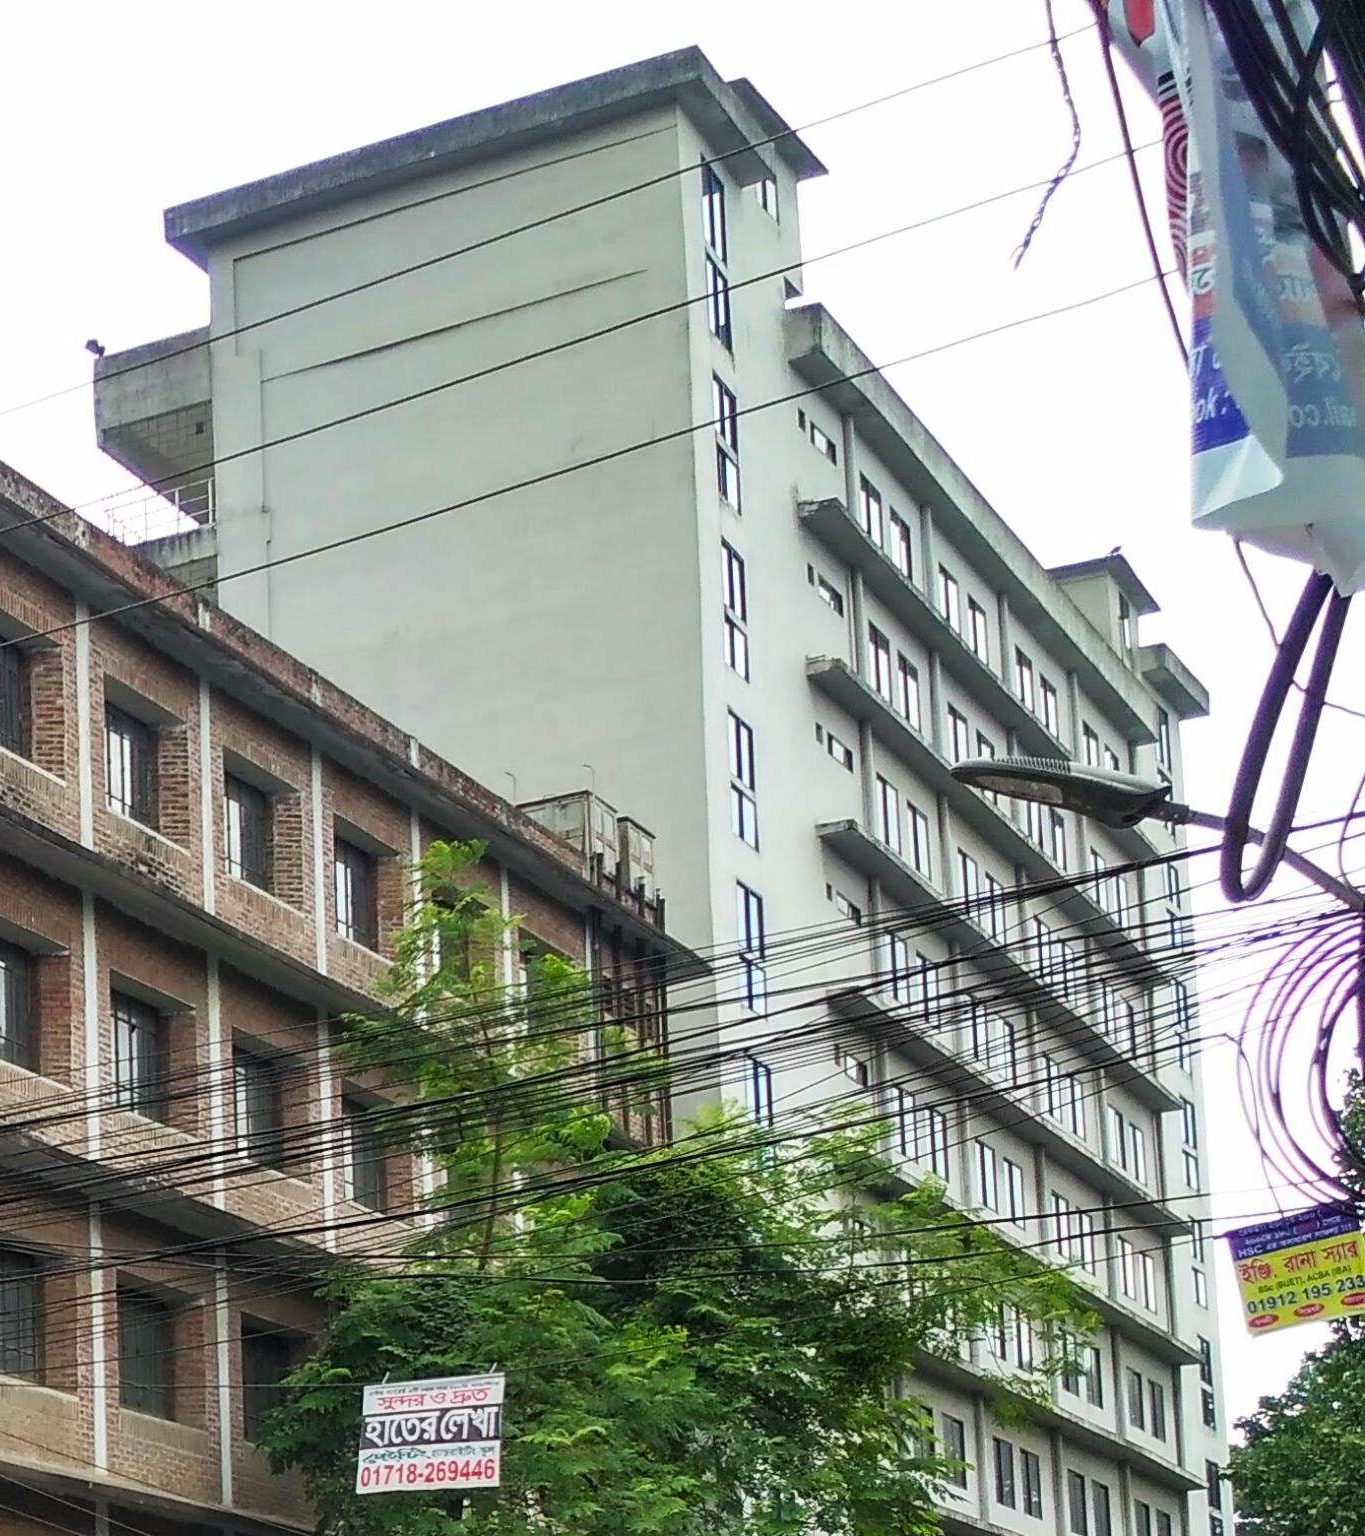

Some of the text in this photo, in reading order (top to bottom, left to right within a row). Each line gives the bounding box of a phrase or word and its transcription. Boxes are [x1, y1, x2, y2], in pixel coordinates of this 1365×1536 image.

[1238, 1245, 1263, 1258] HSC
[1281, 1250, 1317, 1273] রানা
[1320, 1240, 1359, 1263] স্যার
[1247, 1290, 1298, 1314] 01912
[1302, 1283, 1332, 1300] 195
[1335, 1274, 1365, 1293] 233
[377, 1393, 426, 1411] সুন্দর
[429, 1391, 447, 1404] ও
[449, 1387, 492, 1405] দ্রুত
[364, 1406, 500, 1447] হাতের লেখা
[360, 1458, 496, 1488] 01718-269446
